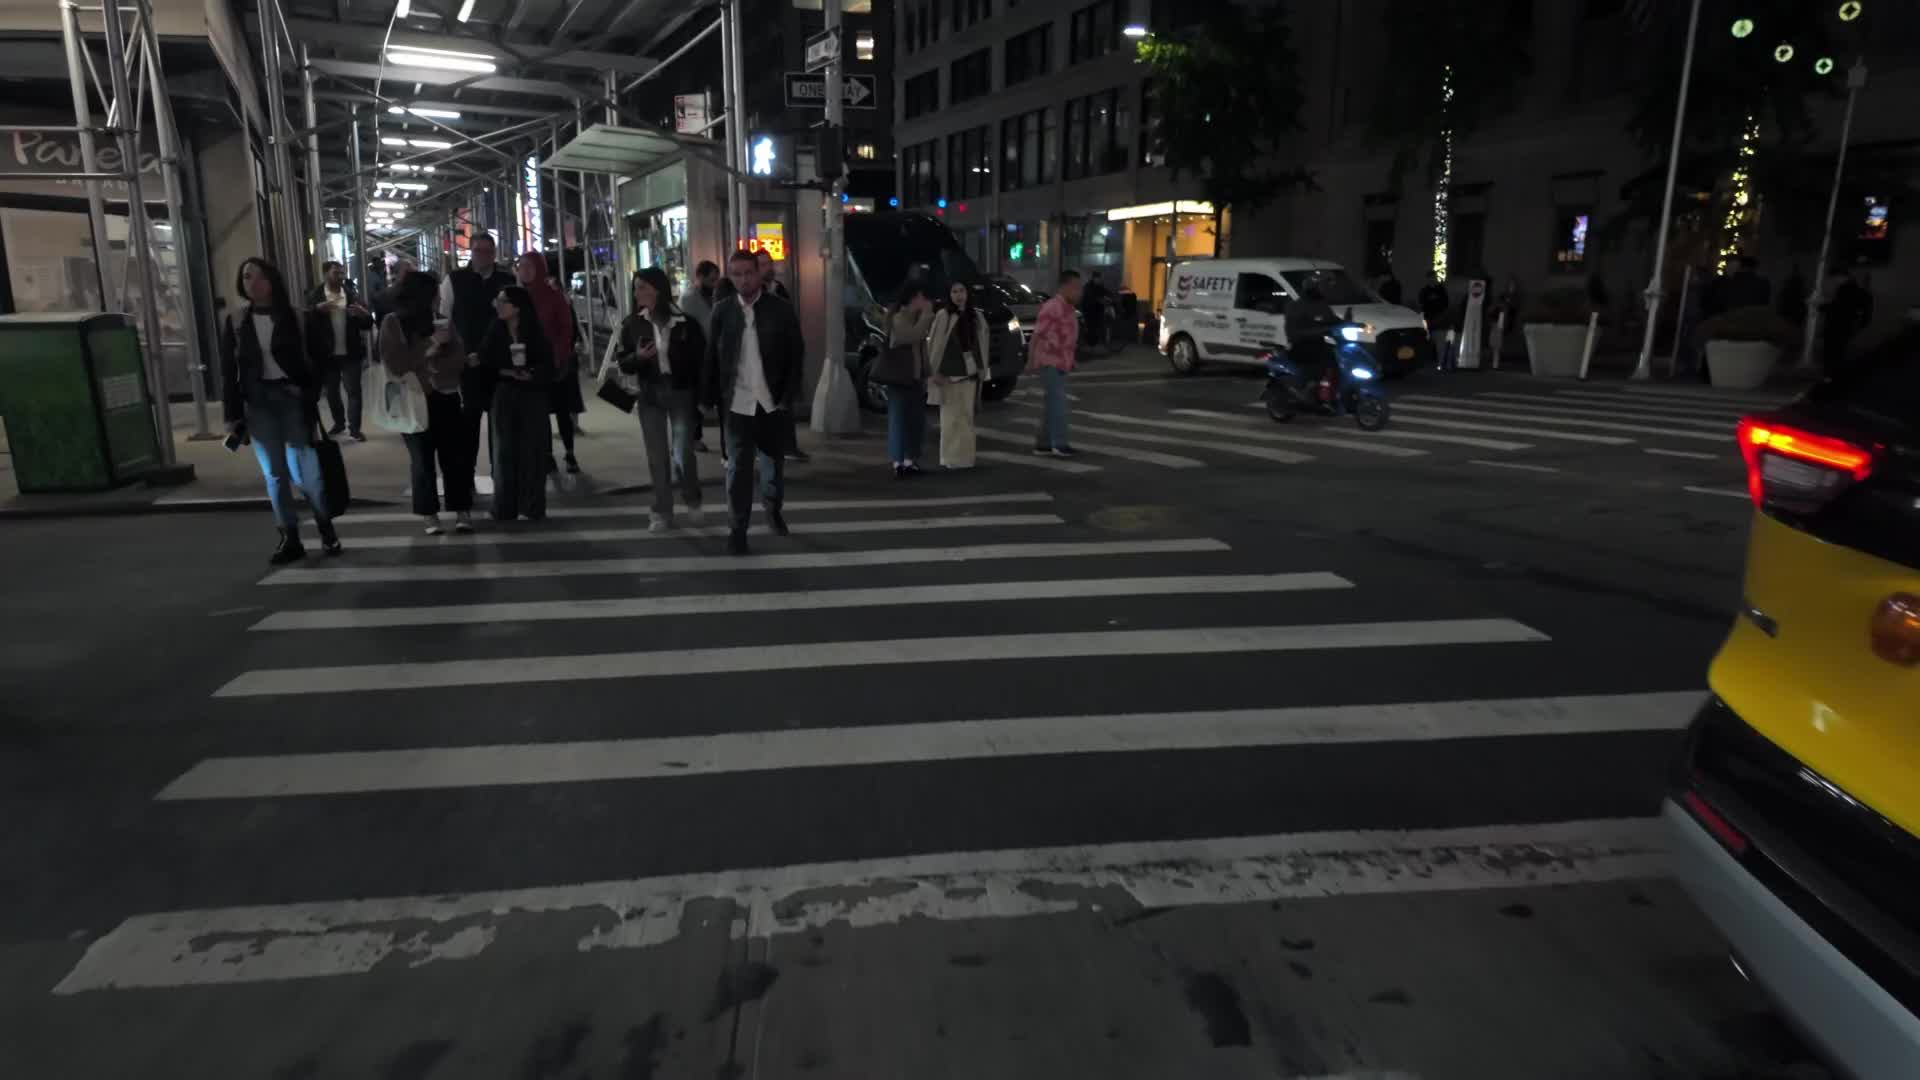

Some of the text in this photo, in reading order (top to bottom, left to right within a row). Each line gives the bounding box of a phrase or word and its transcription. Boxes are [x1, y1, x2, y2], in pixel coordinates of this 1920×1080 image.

[799, 84, 825, 97] ONE
[13, 129, 161, 175] Paea
[1192, 276, 1235, 291] SAFETY
